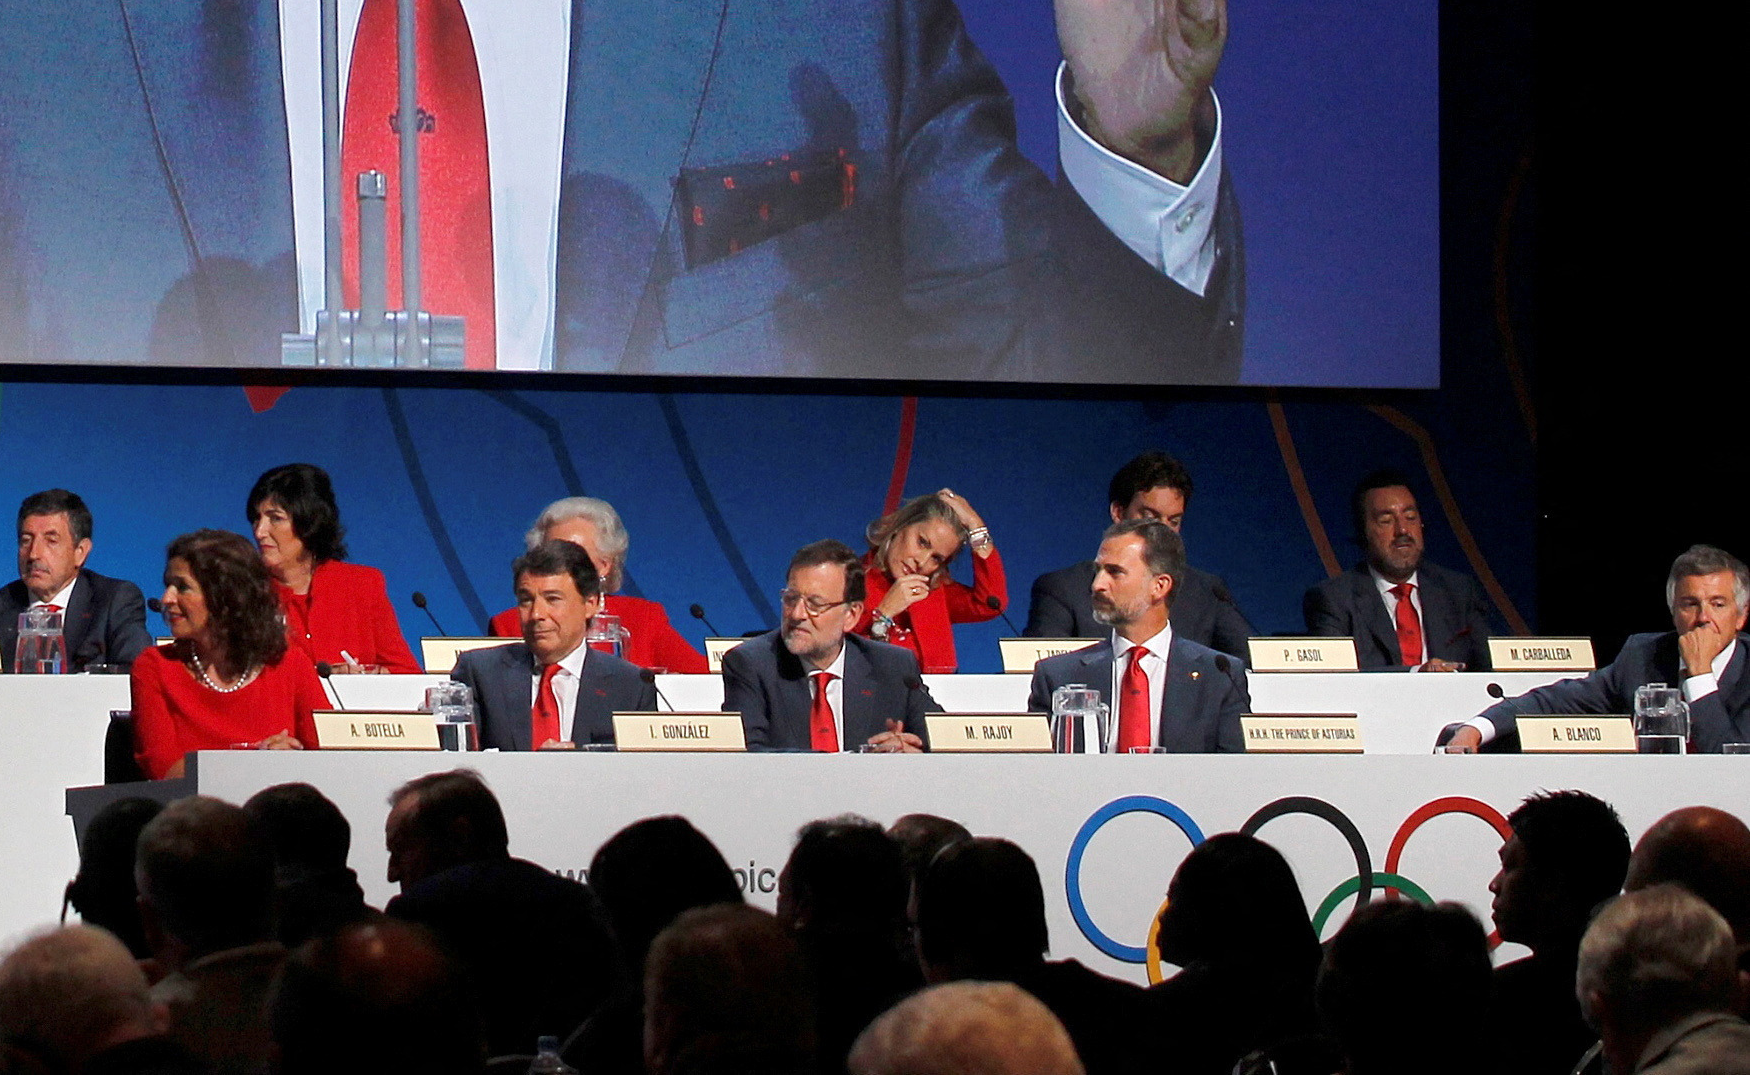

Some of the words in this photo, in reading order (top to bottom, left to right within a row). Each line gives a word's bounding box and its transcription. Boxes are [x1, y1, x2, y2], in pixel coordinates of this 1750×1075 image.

[1283, 649, 1293, 662] P.
[1296, 649, 1324, 662] GASOL
[1510, 648, 1521, 661] M.
[1522, 648, 1572, 661] CARBALLEDA
[350, 723, 360, 738] A.
[366, 723, 405, 738] BOTELLA
[649, 724, 658, 739] I.
[662, 721, 711, 739] GONZÁLEZ
[965, 725, 978, 740] M.
[982, 725, 1013, 740] RAJOY
[1249, 728, 1269, 740] H.R.H.
[1271, 728, 1285, 740] THE
[1285, 728, 1311, 740] PRINCE
[1311, 728, 1321, 740] OF
[1322, 728, 1356, 740] ASTURIAS
[1552, 727, 1562, 741] A.
[1566, 727, 1602, 741] BLANCO
